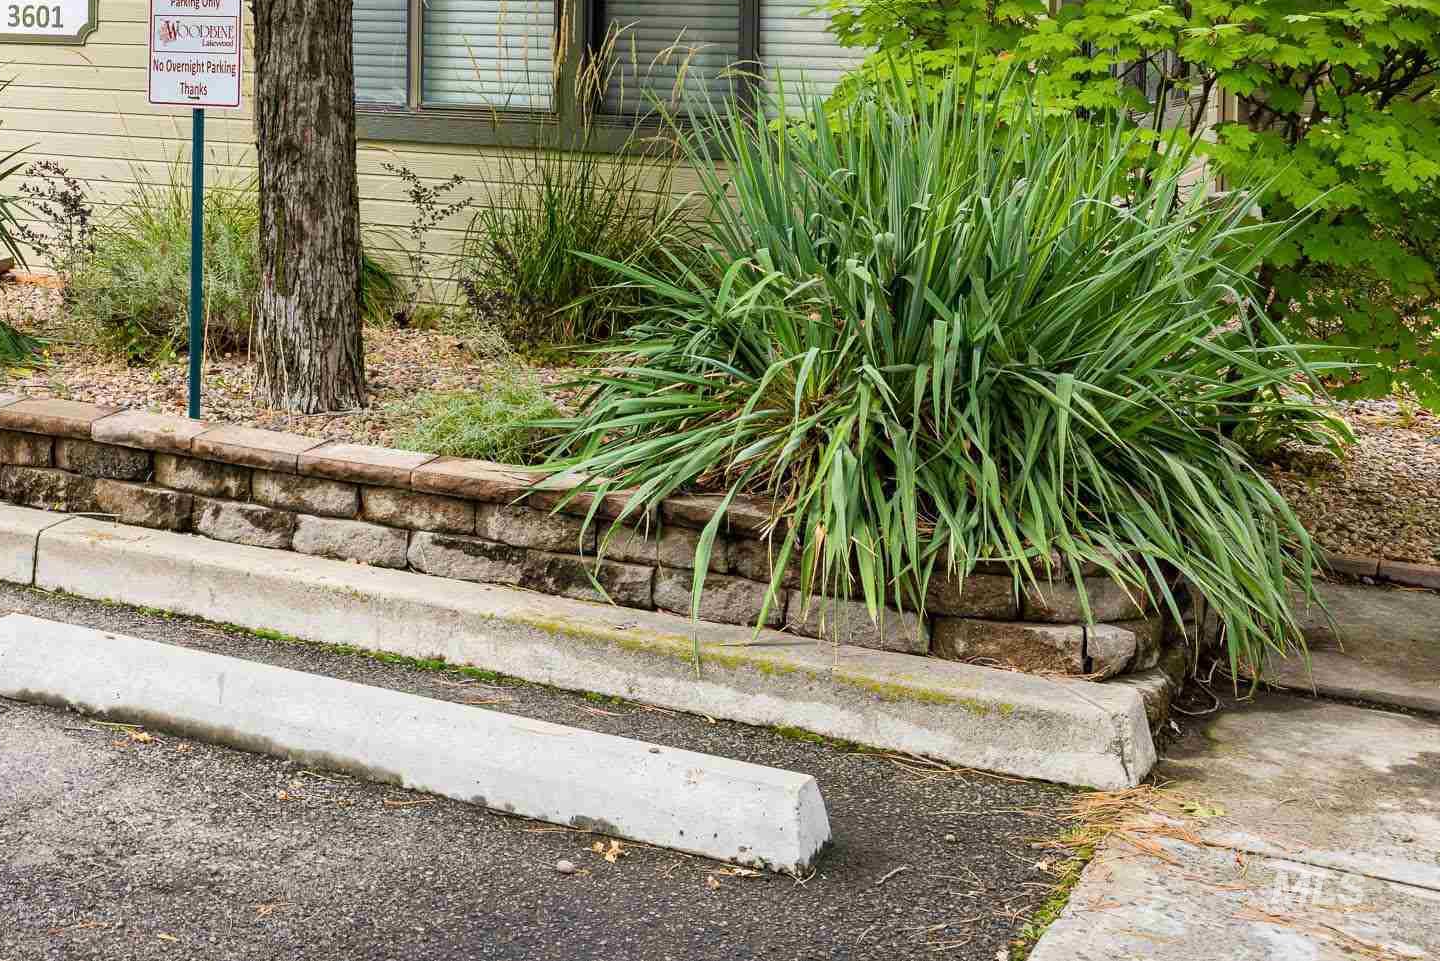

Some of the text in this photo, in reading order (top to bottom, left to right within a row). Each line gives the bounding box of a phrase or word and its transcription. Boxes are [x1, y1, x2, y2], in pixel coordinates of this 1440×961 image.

[7, 4, 64, 29] 3601
[153, 58, 237, 77] No Overnight Parking
[180, 82, 208, 96] Thanks
